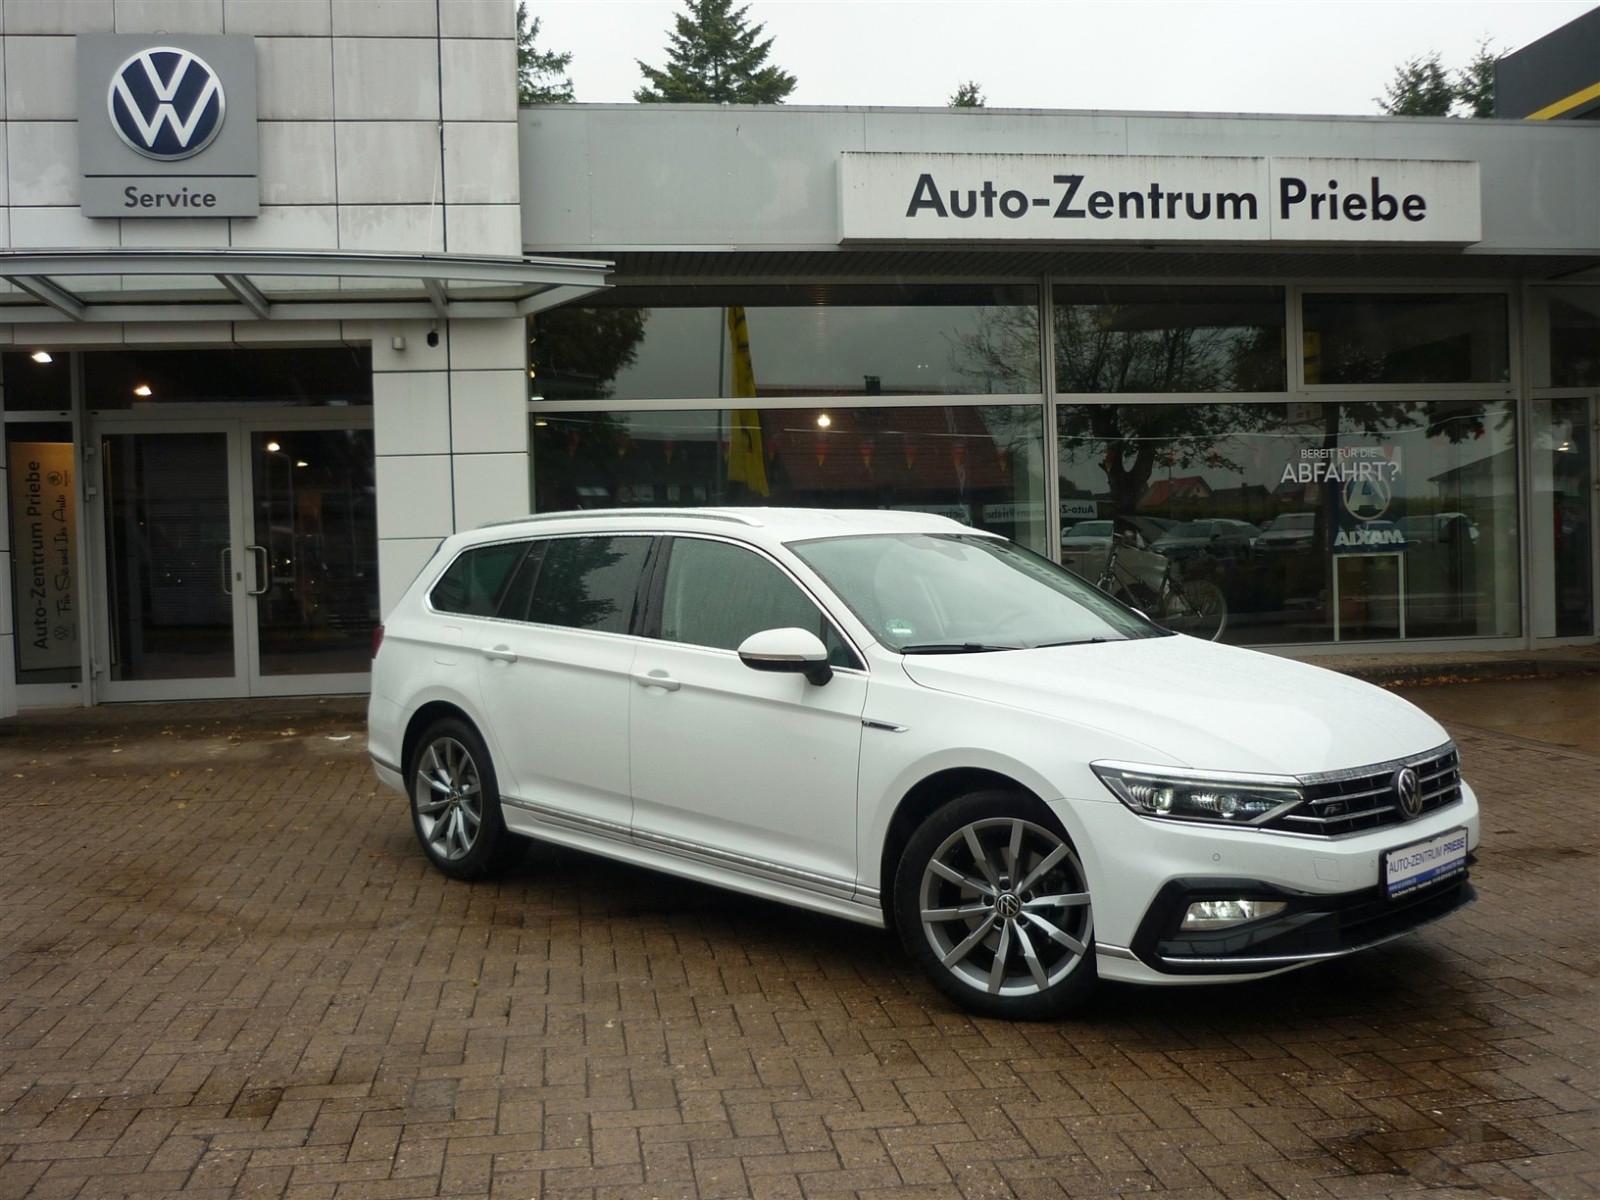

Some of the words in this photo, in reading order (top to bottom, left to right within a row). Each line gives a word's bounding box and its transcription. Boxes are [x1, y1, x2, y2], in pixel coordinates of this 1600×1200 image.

[124, 185, 217, 208] Service
[905, 173, 1258, 221] Auto-Zentrum
[1279, 175, 1427, 222] Priebe
[1301, 448, 1334, 459] BEREIT
[1337, 446, 1358, 459] FÜR
[1360, 448, 1377, 458] DIE
[1280, 461, 1400, 484] ABFAHRT?
[26, 461, 42, 517] Priebe
[1333, 529, 1406, 547] AIXAM
[31, 522, 48, 650] Auto-Zentrum
